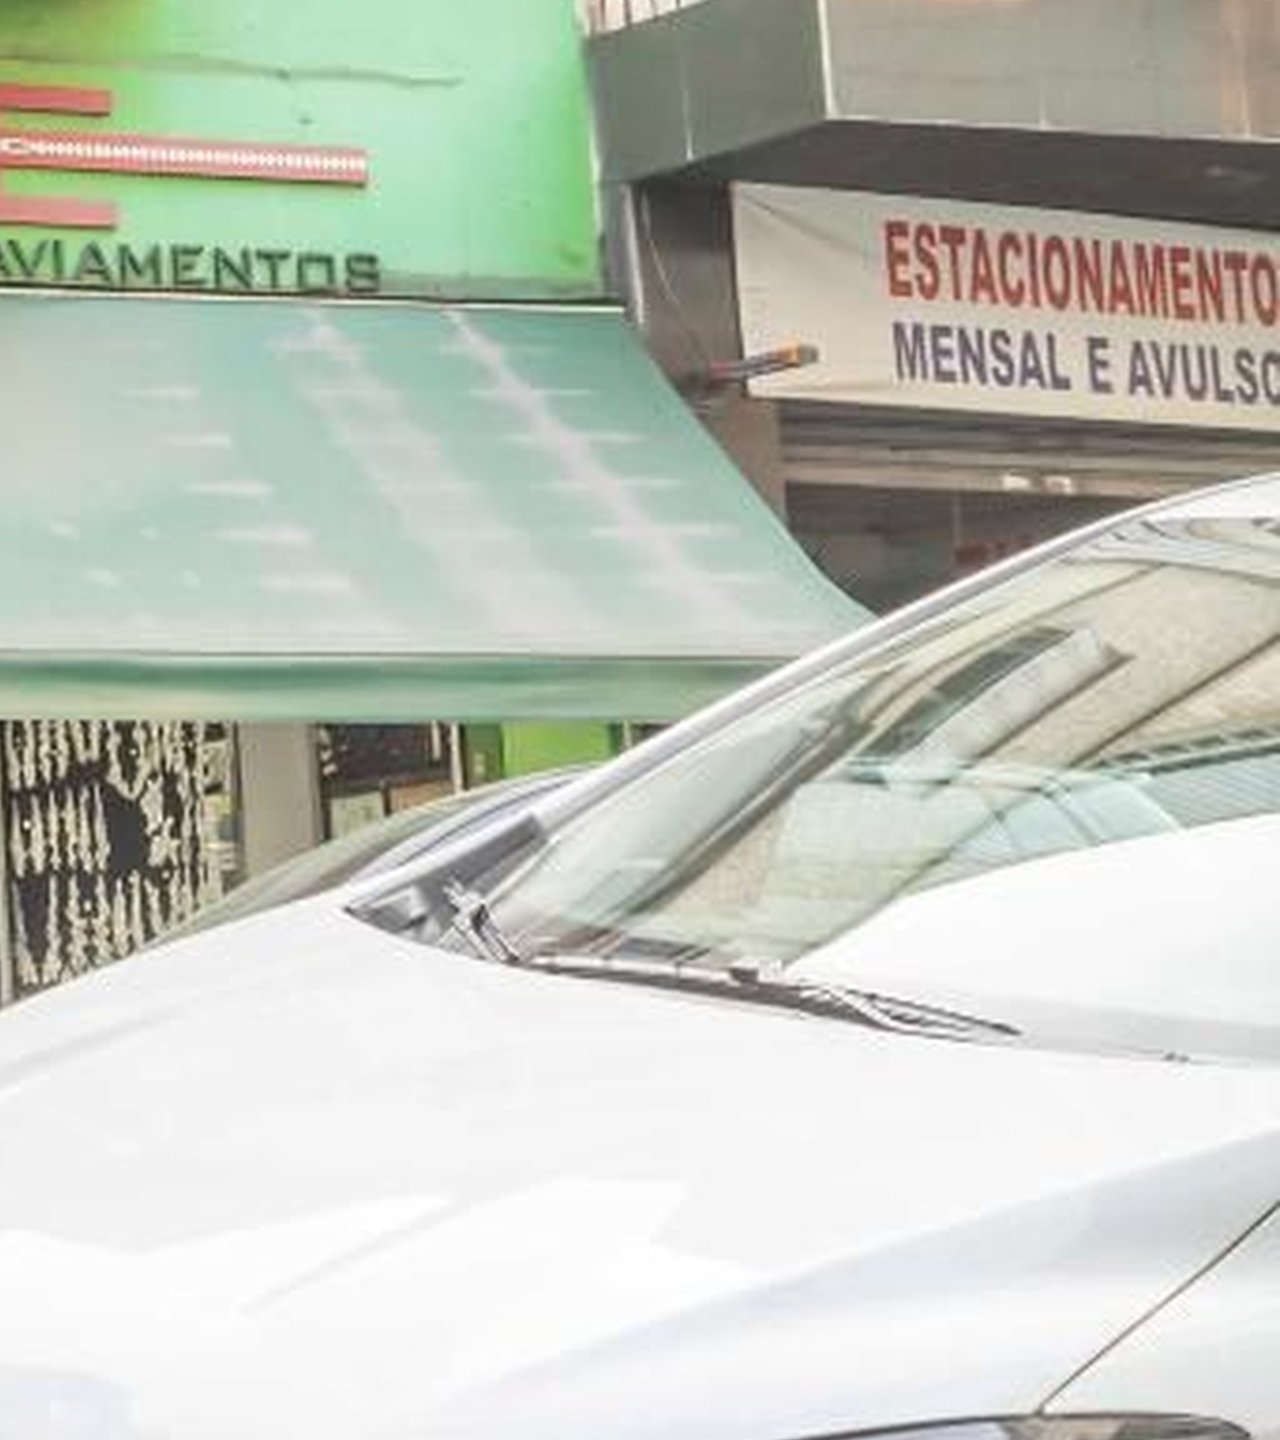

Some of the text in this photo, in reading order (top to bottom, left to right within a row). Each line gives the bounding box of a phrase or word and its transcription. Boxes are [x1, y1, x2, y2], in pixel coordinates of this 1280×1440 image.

[884, 219, 1280, 327] ESTACIONAMENTO
[892, 320, 1071, 391] MENSAL
[1087, 336, 1114, 395] E
